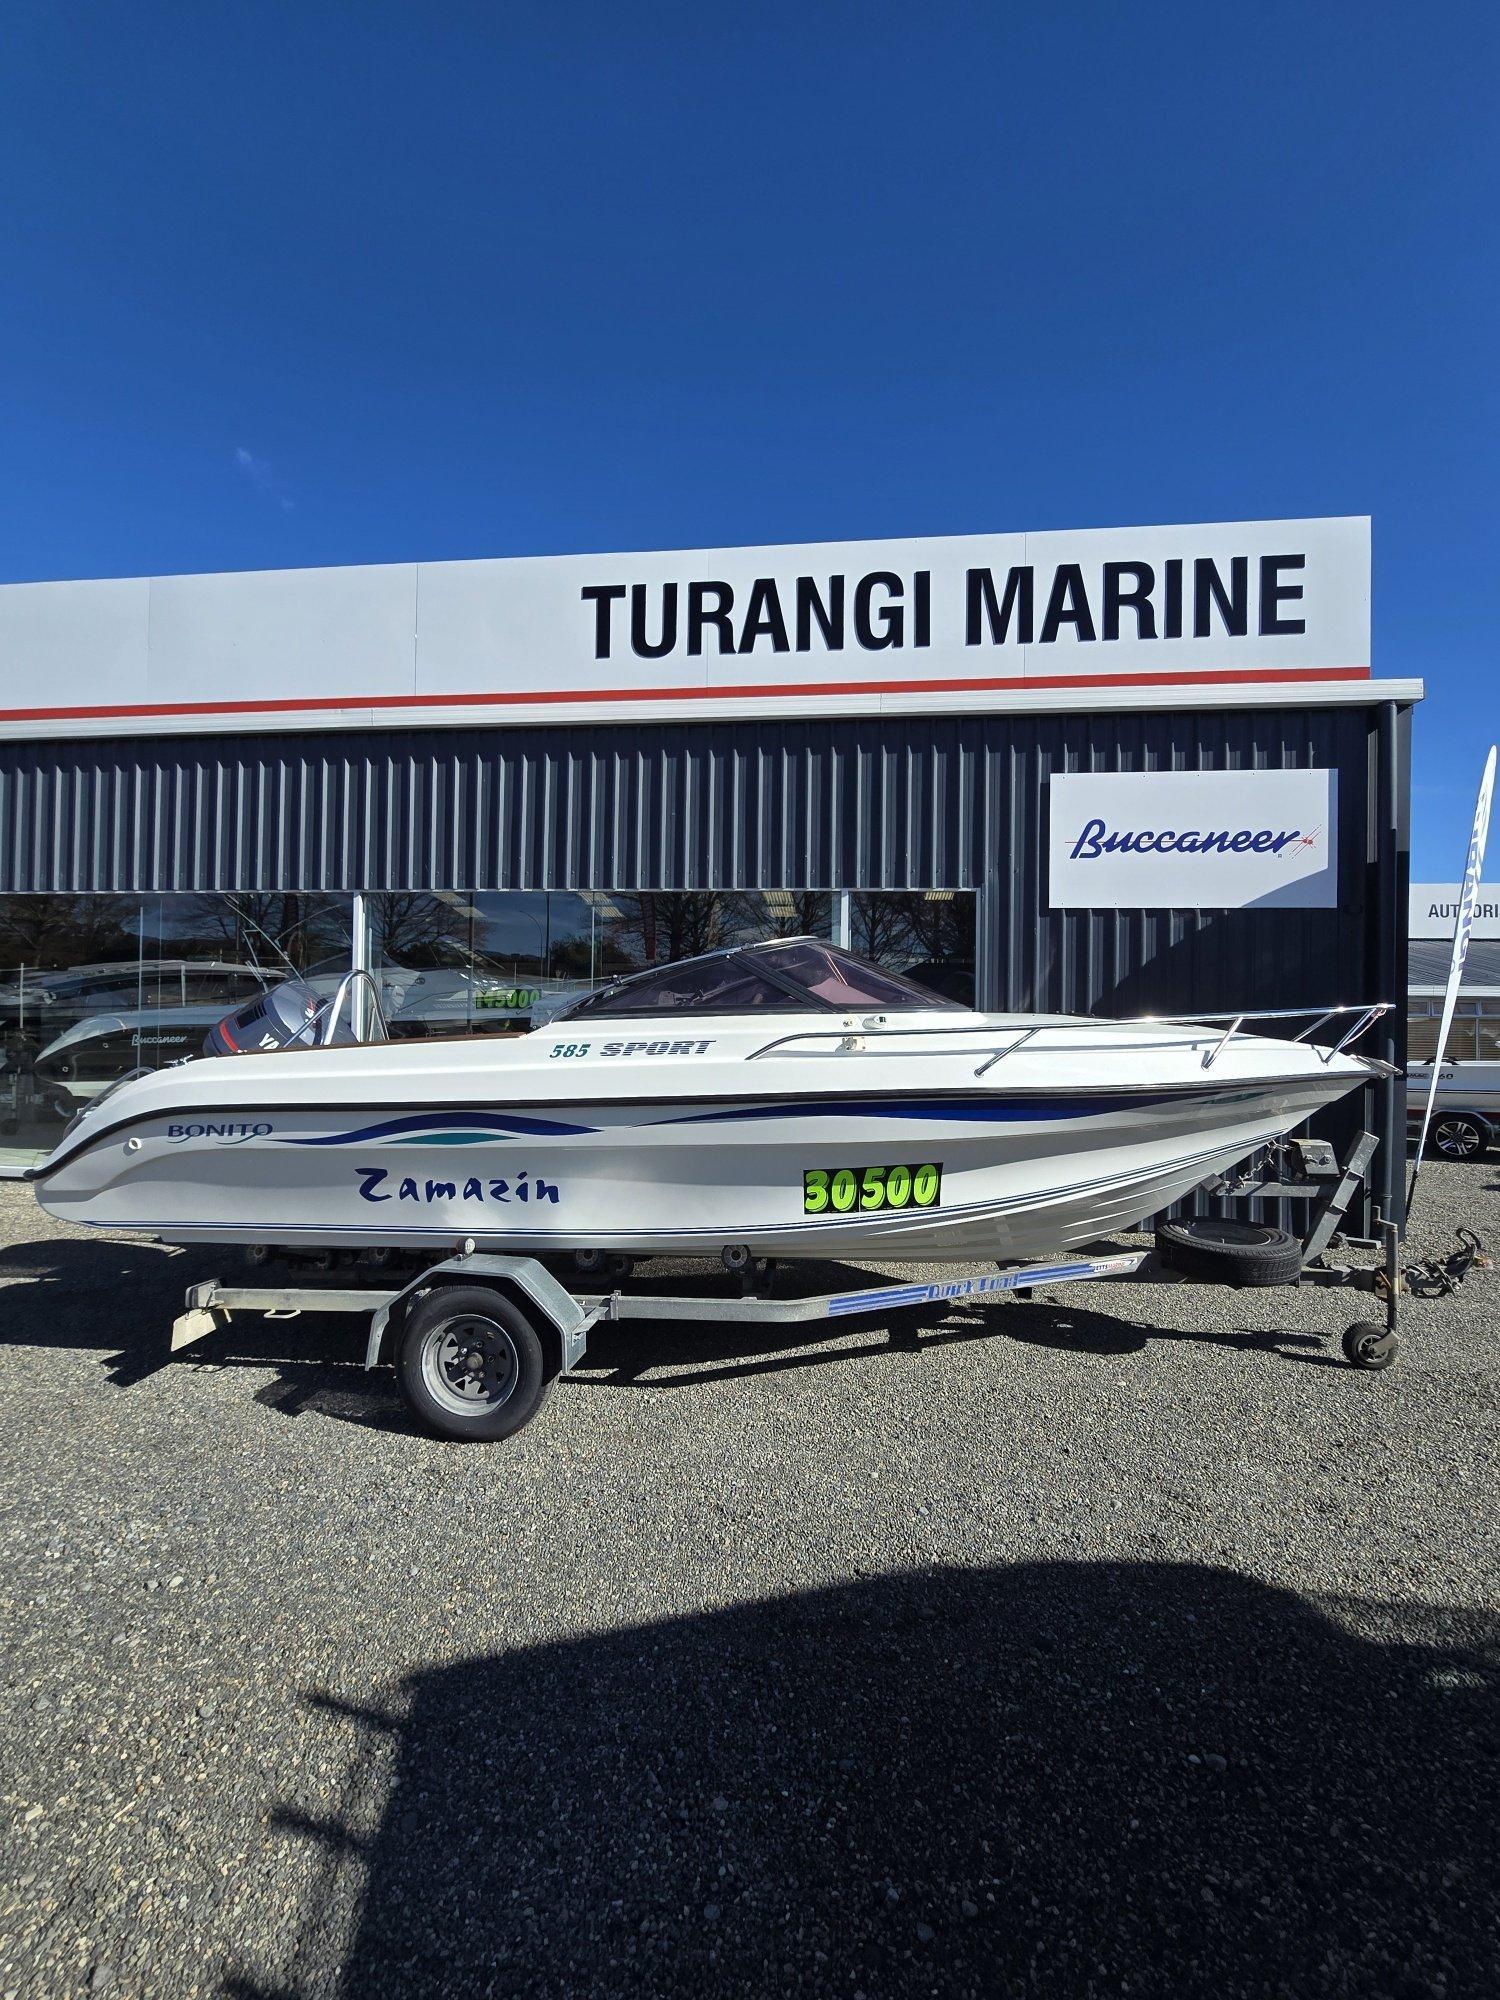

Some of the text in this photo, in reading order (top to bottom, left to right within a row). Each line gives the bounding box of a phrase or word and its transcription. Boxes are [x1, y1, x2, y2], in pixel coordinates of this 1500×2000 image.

[582, 553, 1306, 660] TURANGI MARINE
[1069, 818, 1301, 860] Buccaneer
[1428, 903, 1499, 918] AUTORI
[131, 1034, 187, 1046] Buccaneer
[549, 1040, 717, 1058] 585 SPORT
[167, 1123, 273, 1142] BONITO
[354, 1167, 560, 1204] Zamazin
[804, 1164, 939, 1213] 30500
